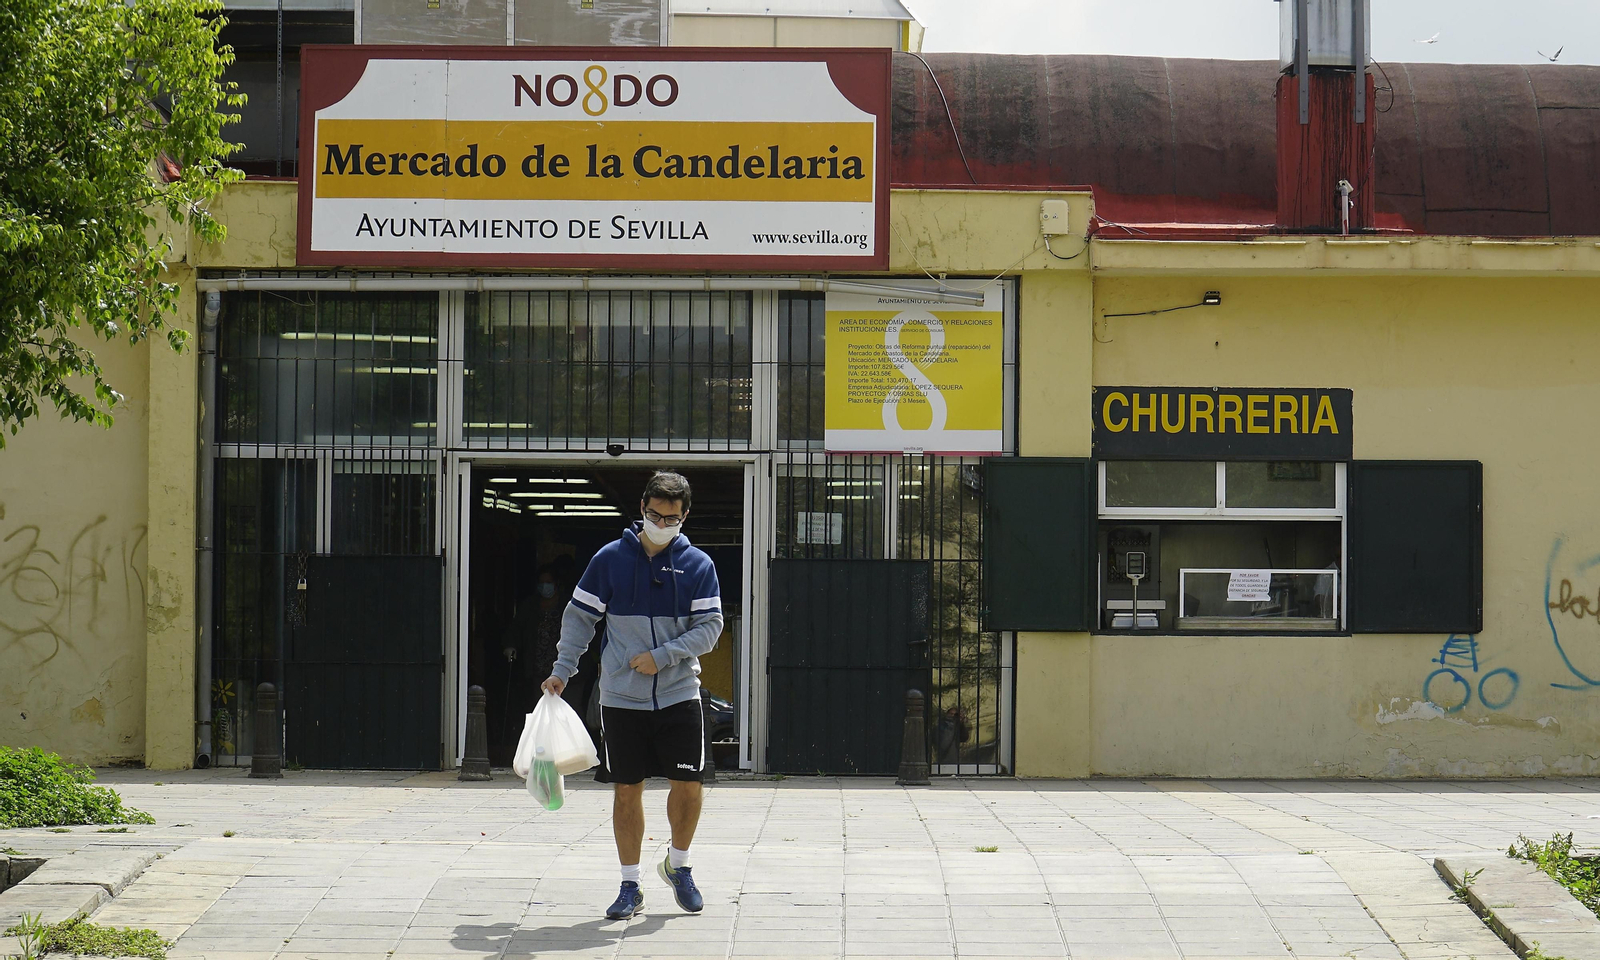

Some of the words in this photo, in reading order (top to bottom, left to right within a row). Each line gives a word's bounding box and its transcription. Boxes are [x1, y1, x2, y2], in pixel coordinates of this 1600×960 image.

[321, 143, 507, 178] Mercado
[520, 143, 571, 179] de
[585, 144, 625, 180] la
[632, 145, 866, 181] Candelaria
[355, 212, 559, 240] AYUNTAMIENTO
[568, 219, 602, 240] DE
[610, 215, 710, 241] SEVILLA
[752, 228, 869, 251] www.sevilla.org
[908, 319, 944, 327] COMERCIO
[950, 319, 993, 327] RELACIONES
[847, 343, 875, 351] Proyecto:
[847, 356, 877, 364] Ubicación:
[1101, 391, 1340, 435] CHURRERIA
